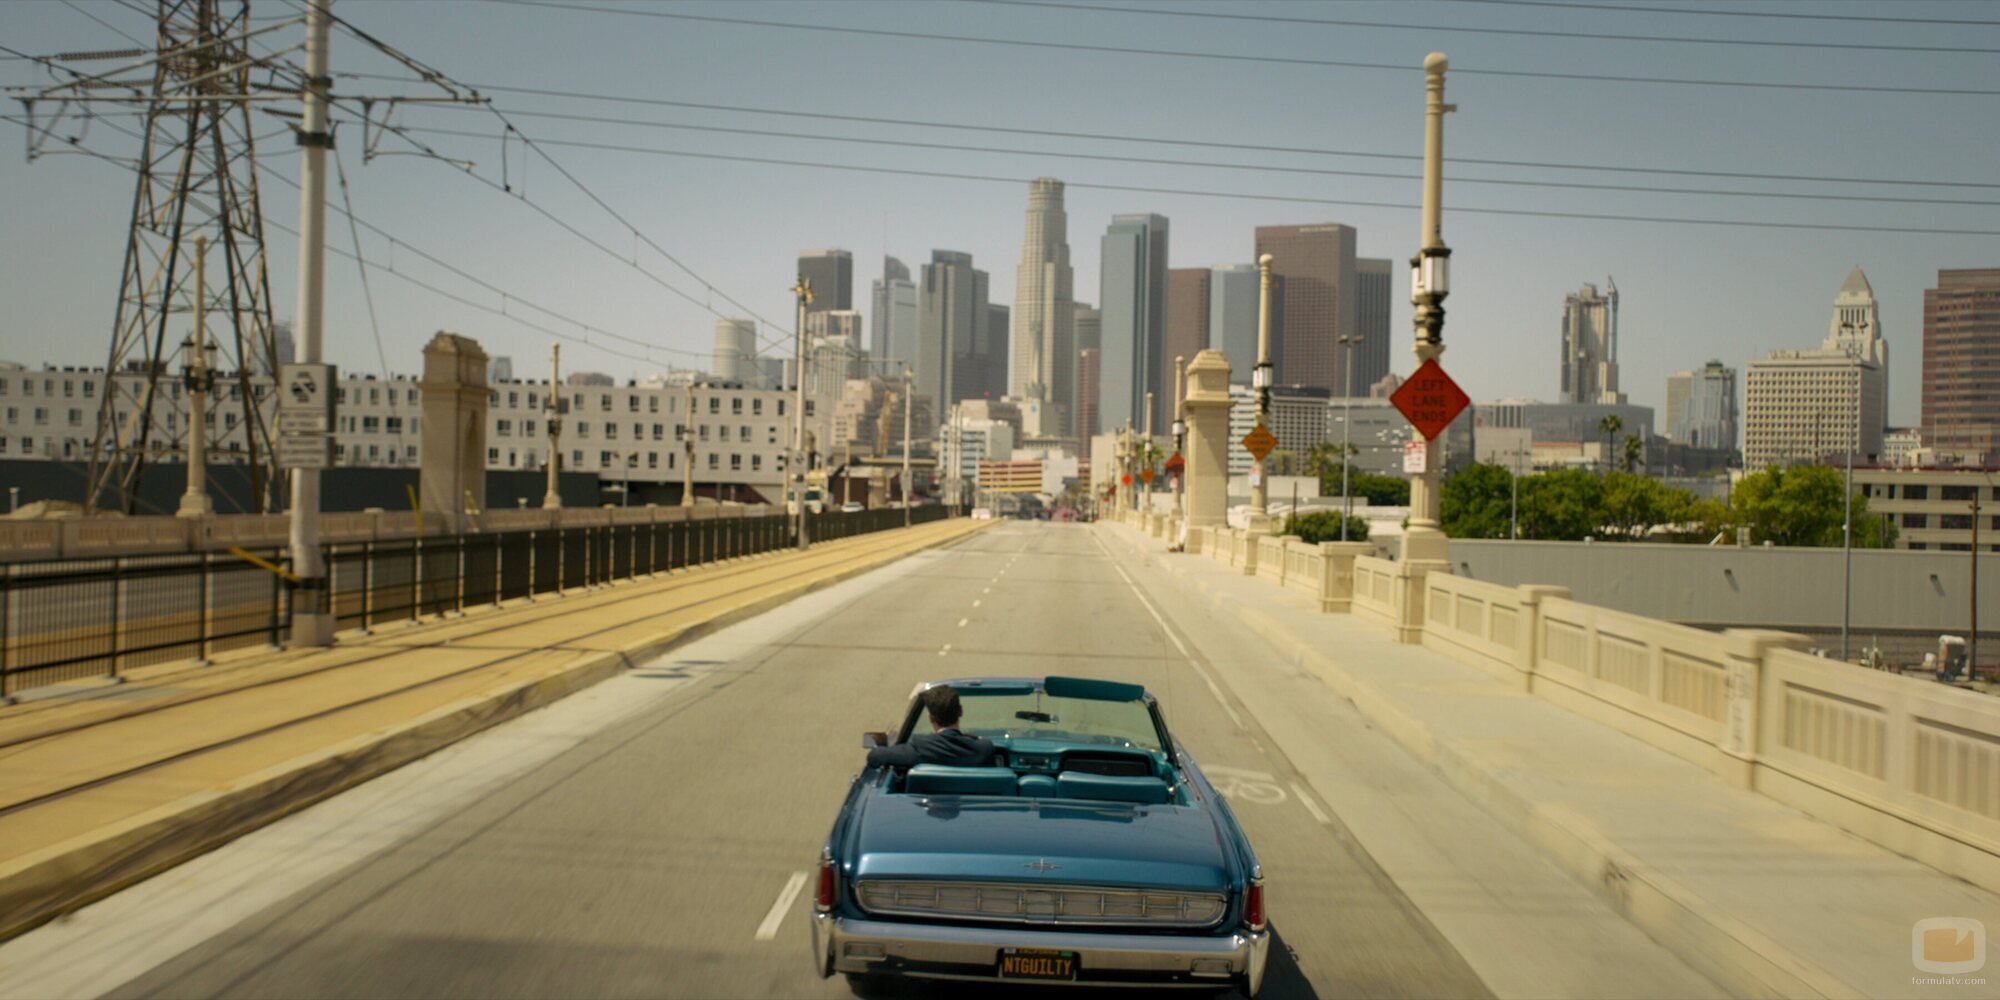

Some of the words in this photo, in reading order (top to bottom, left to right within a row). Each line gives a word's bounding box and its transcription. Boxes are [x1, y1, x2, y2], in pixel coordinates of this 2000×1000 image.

[1414, 379, 1446, 391] LEFT
[1413, 395, 1446, 407] LANE
[1413, 410, 1446, 422] ENDS
[1004, 956, 1072, 976] NTGUILTY
